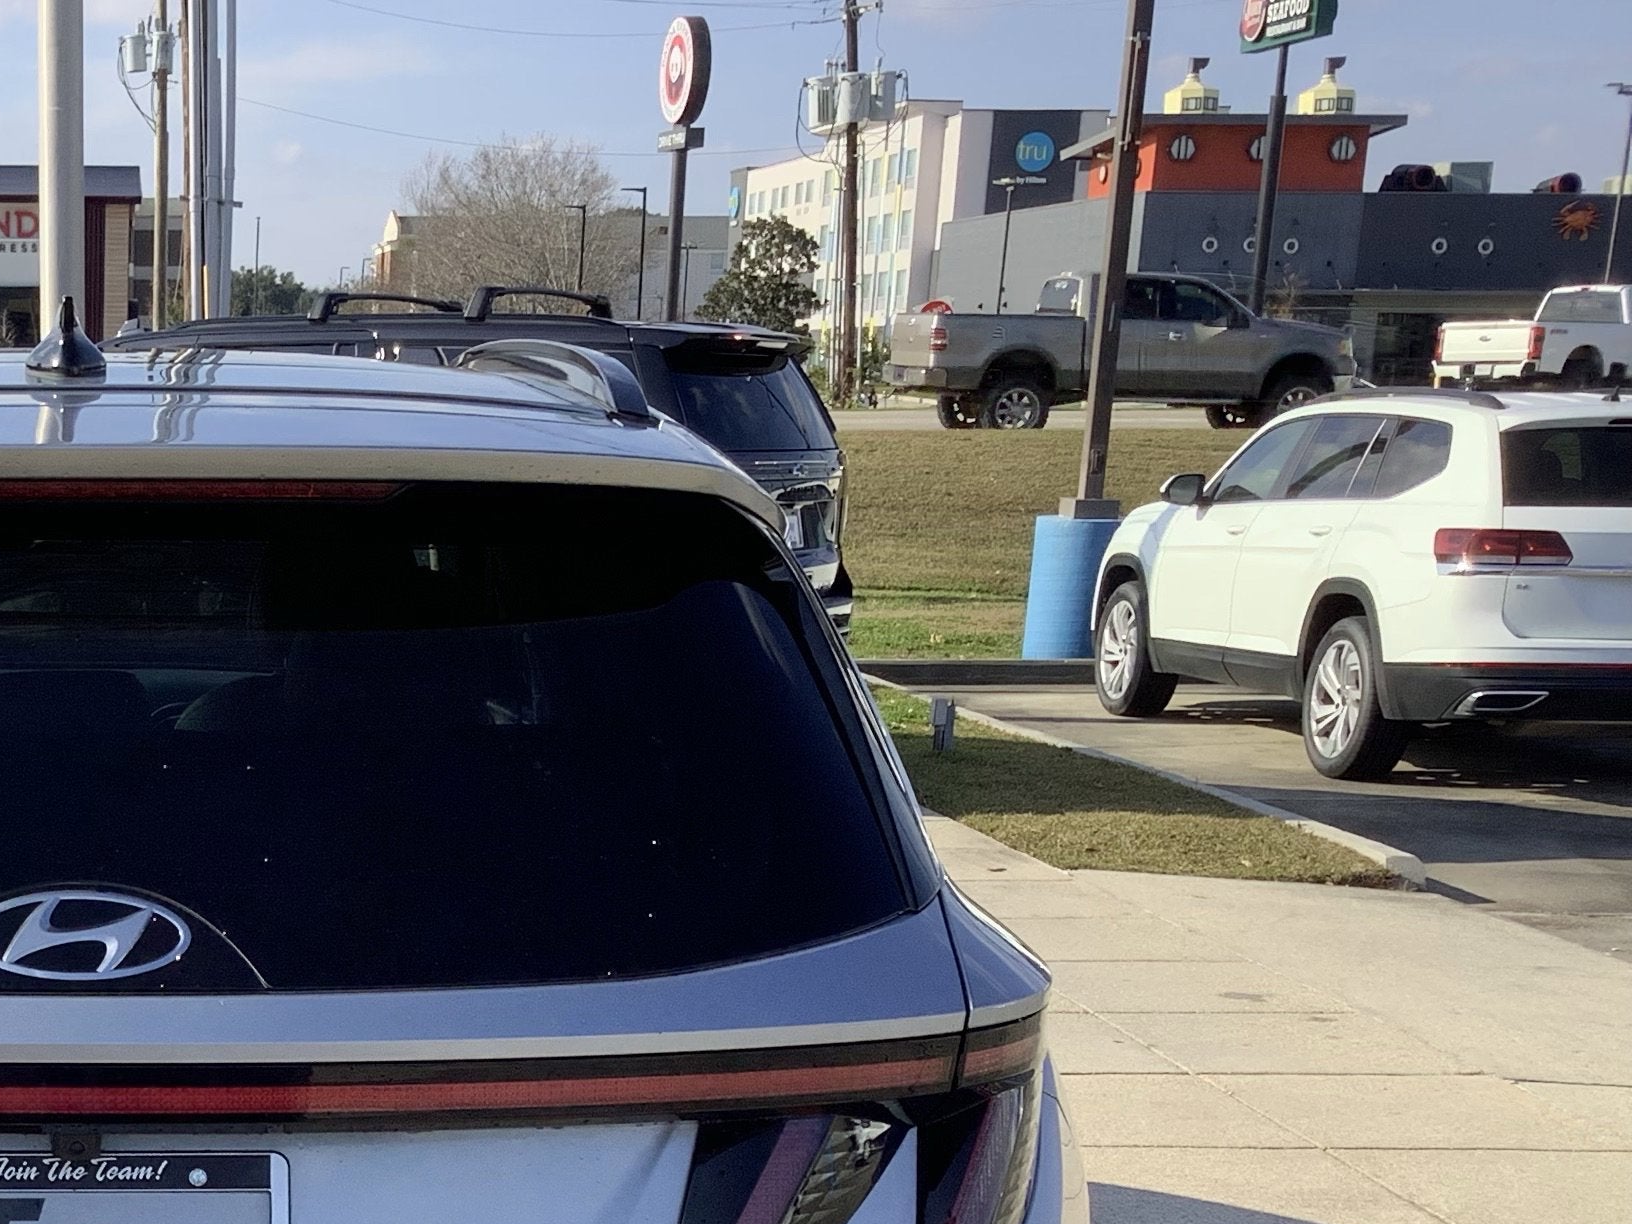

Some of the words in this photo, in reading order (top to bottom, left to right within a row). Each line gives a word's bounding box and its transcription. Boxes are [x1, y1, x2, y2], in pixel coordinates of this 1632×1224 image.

[1266, 0, 1309, 23] SEAFOOD
[1018, 140, 1047, 160] tru
[42, 1157, 88, 1182] The
[90, 1157, 168, 1182] Team!
